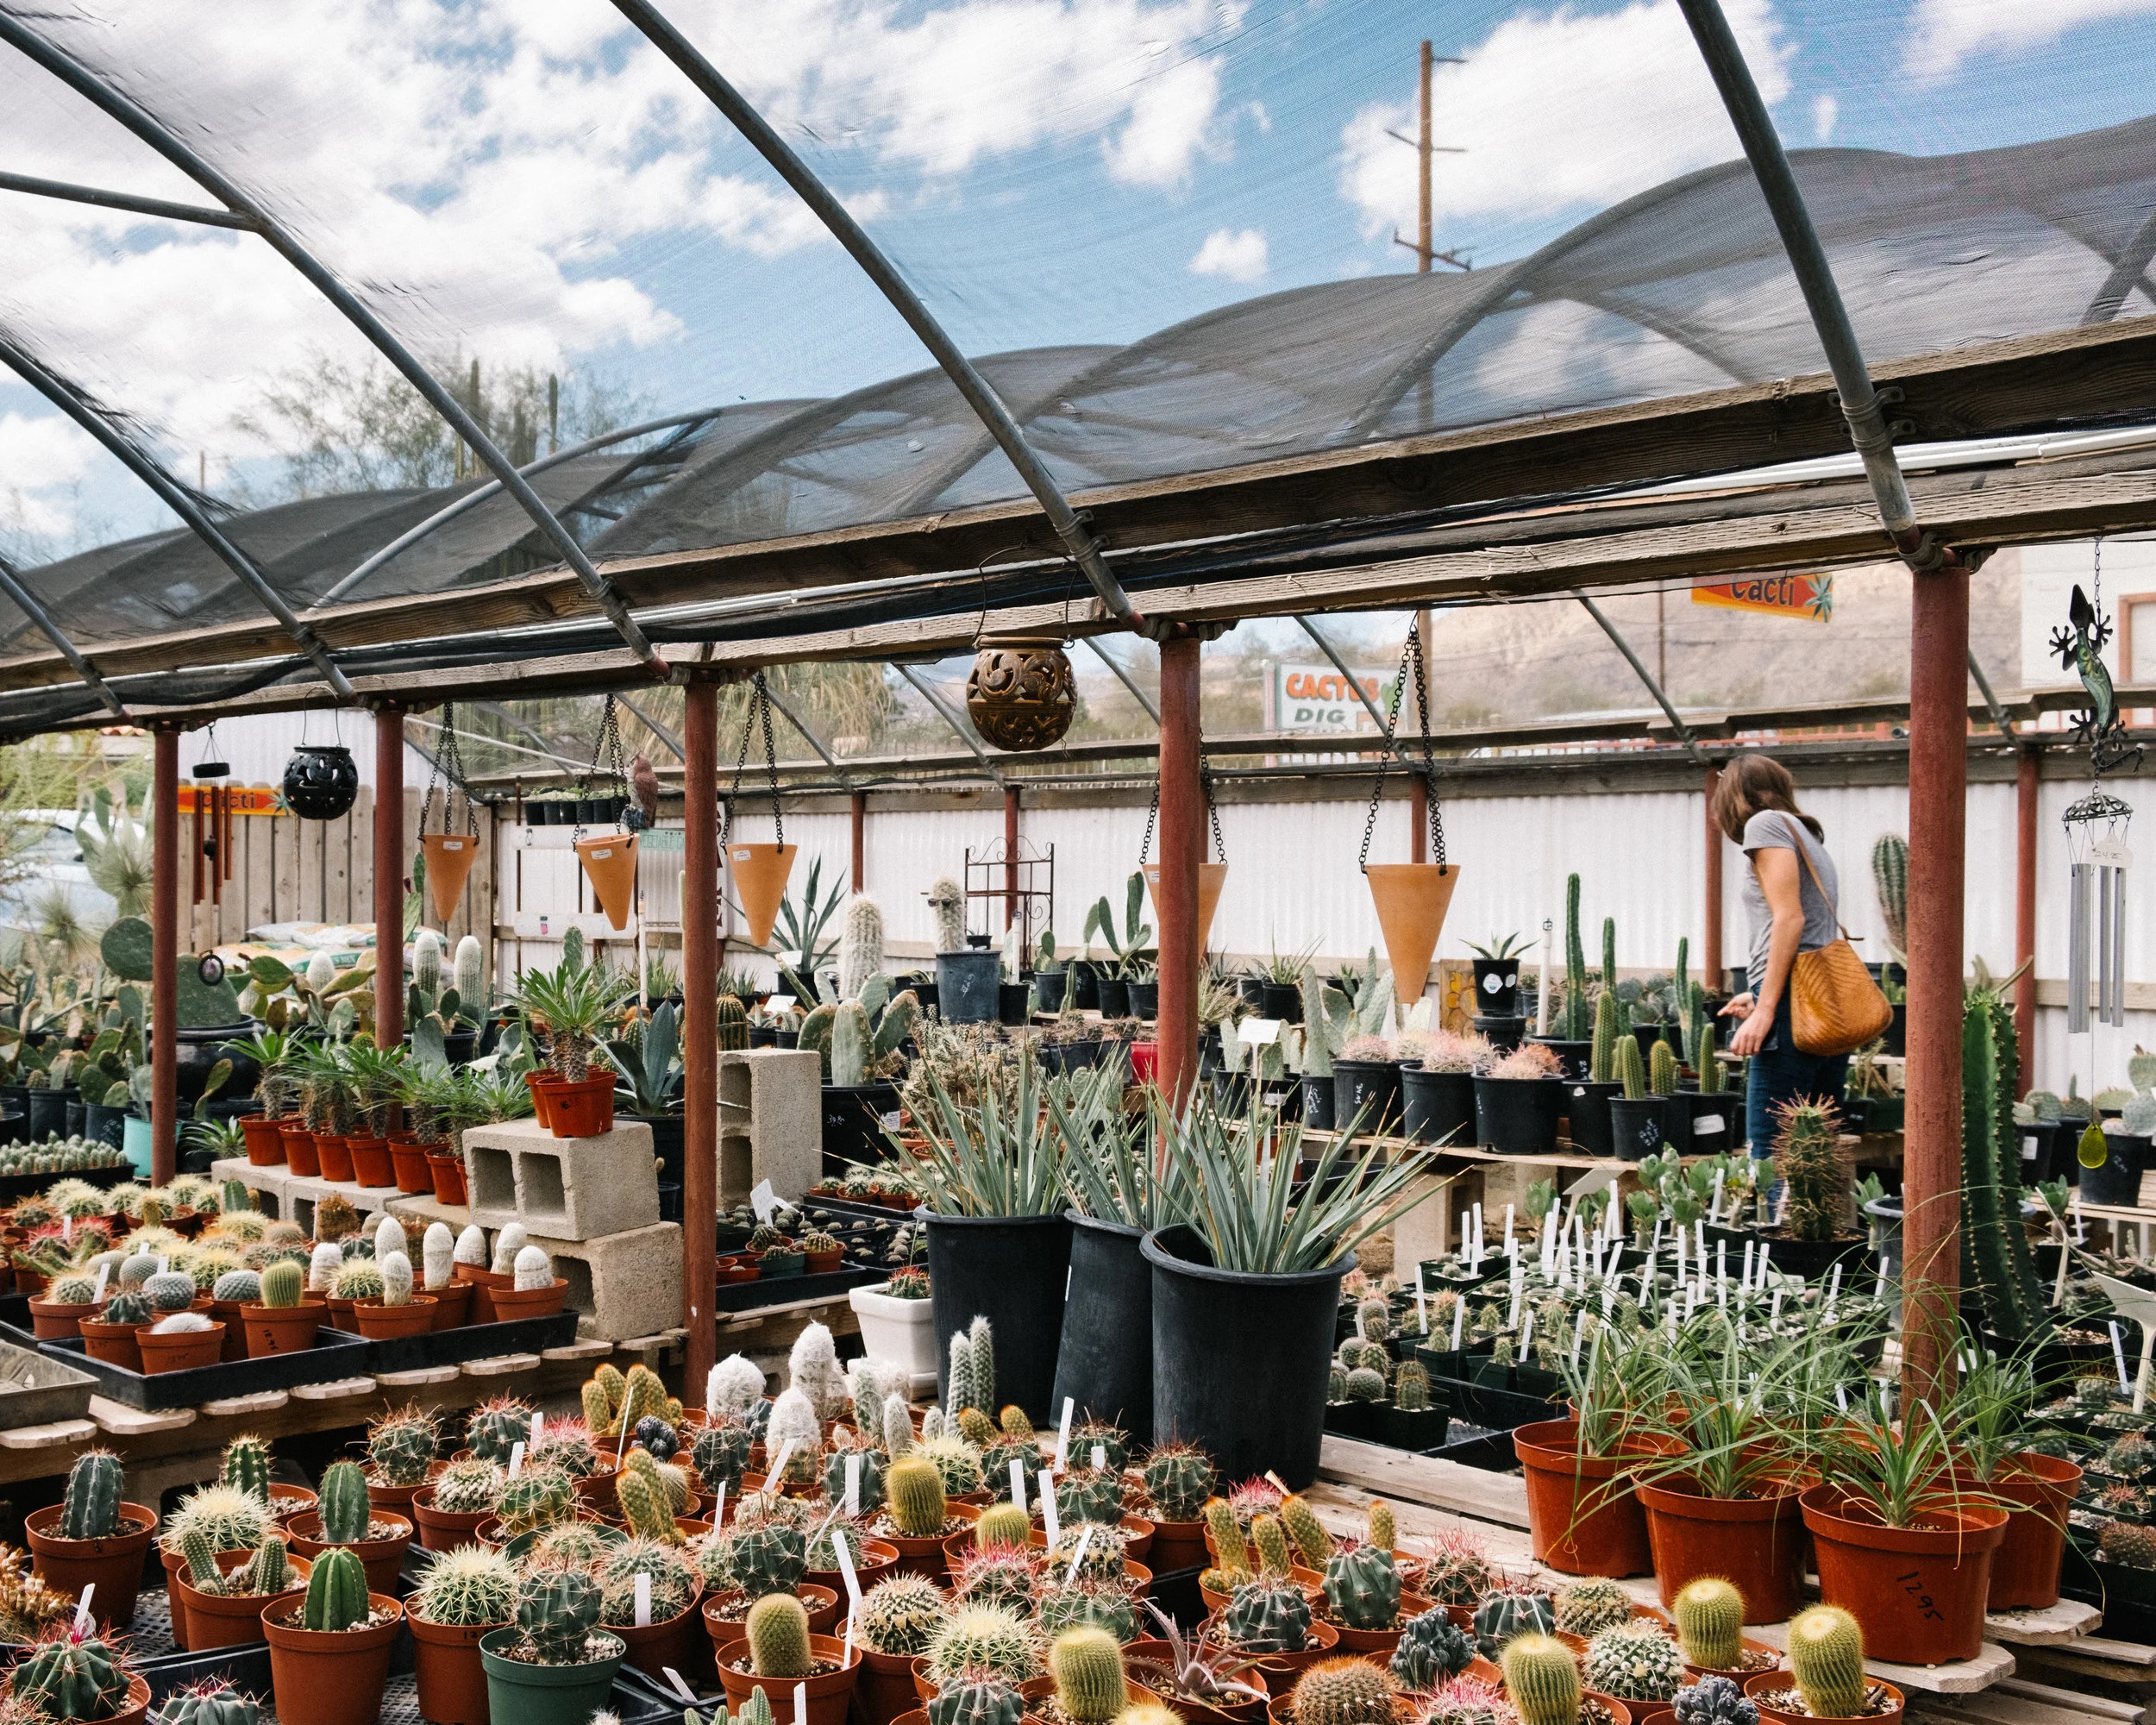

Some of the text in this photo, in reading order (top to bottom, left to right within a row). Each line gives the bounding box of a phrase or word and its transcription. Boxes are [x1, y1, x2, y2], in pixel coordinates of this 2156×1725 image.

[1286, 673, 1380, 702] CACTUS
[1294, 707, 1346, 724] DIG
[202, 792, 255, 809] Ccti
[1896, 1571, 1945, 1621] 12.95
